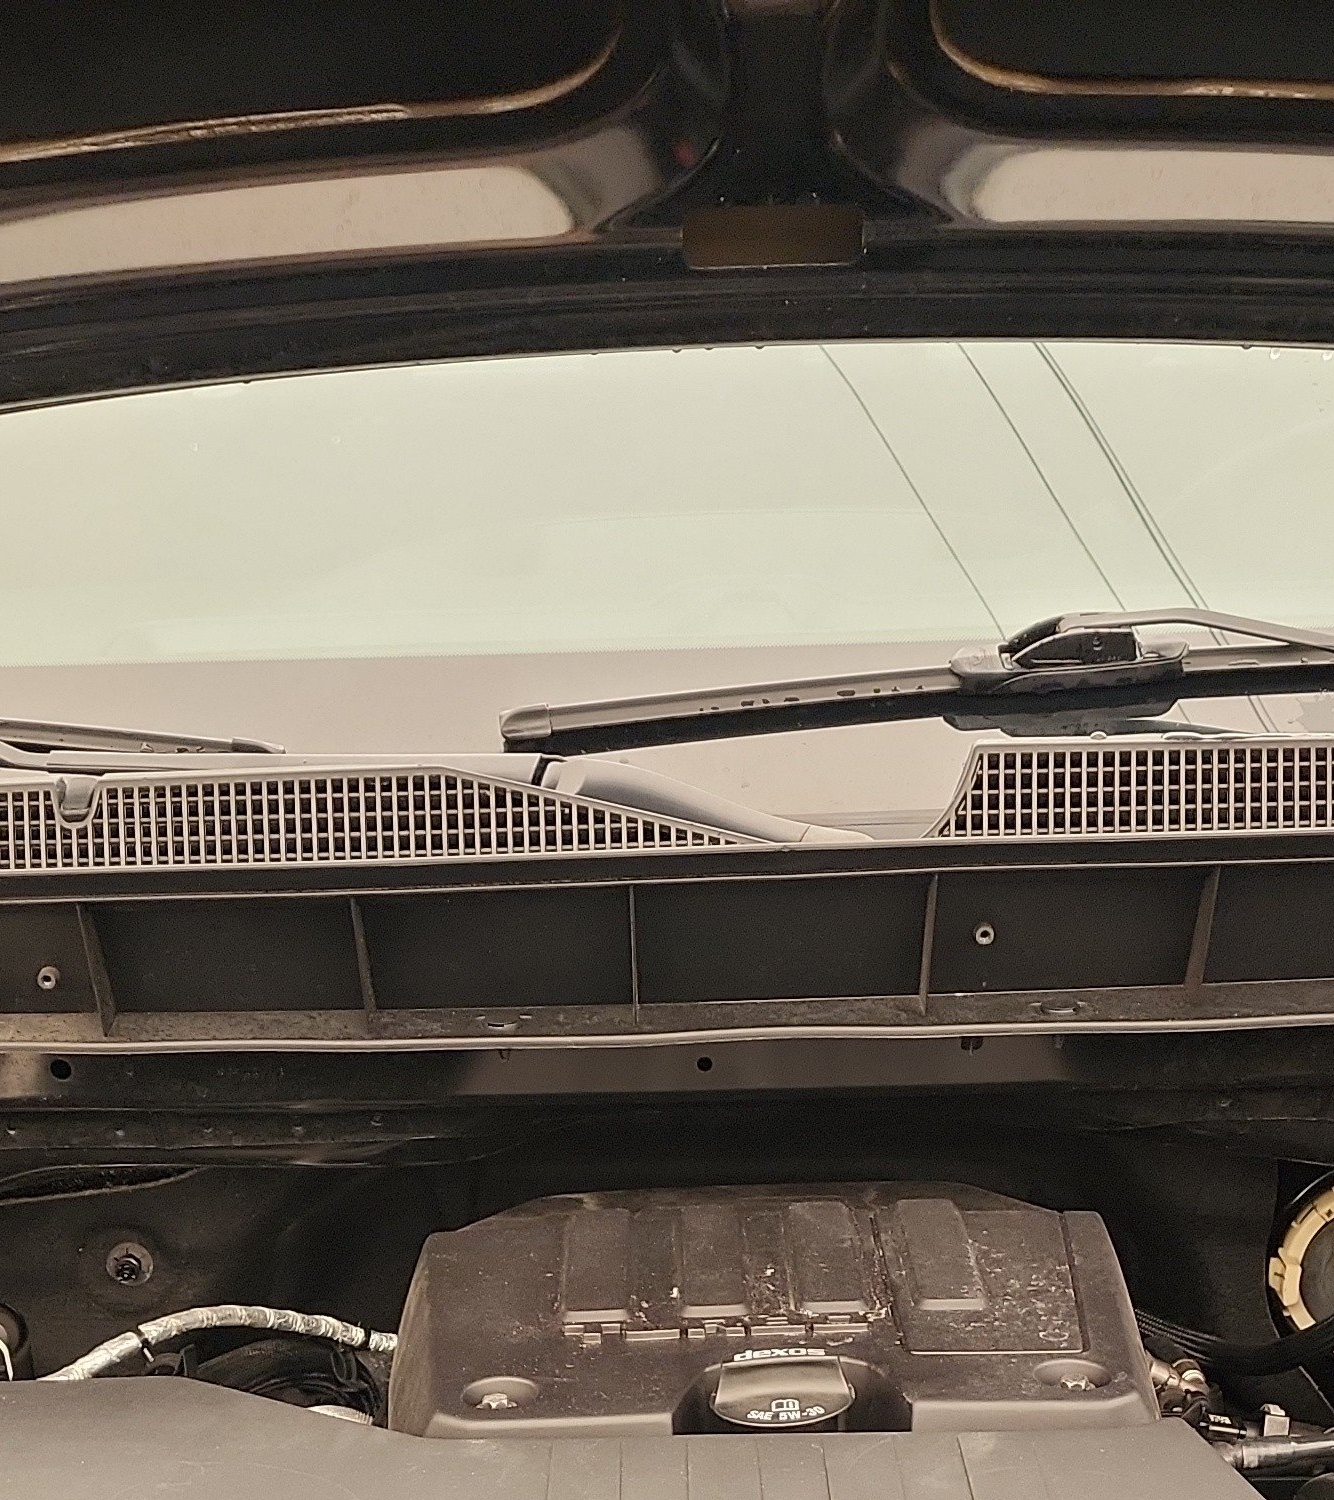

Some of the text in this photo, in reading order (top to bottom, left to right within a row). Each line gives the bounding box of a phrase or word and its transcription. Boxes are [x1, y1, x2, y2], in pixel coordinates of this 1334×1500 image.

[733, 1348, 826, 1362] dexos
[746, 1405, 826, 1421] SAE 5W-30
